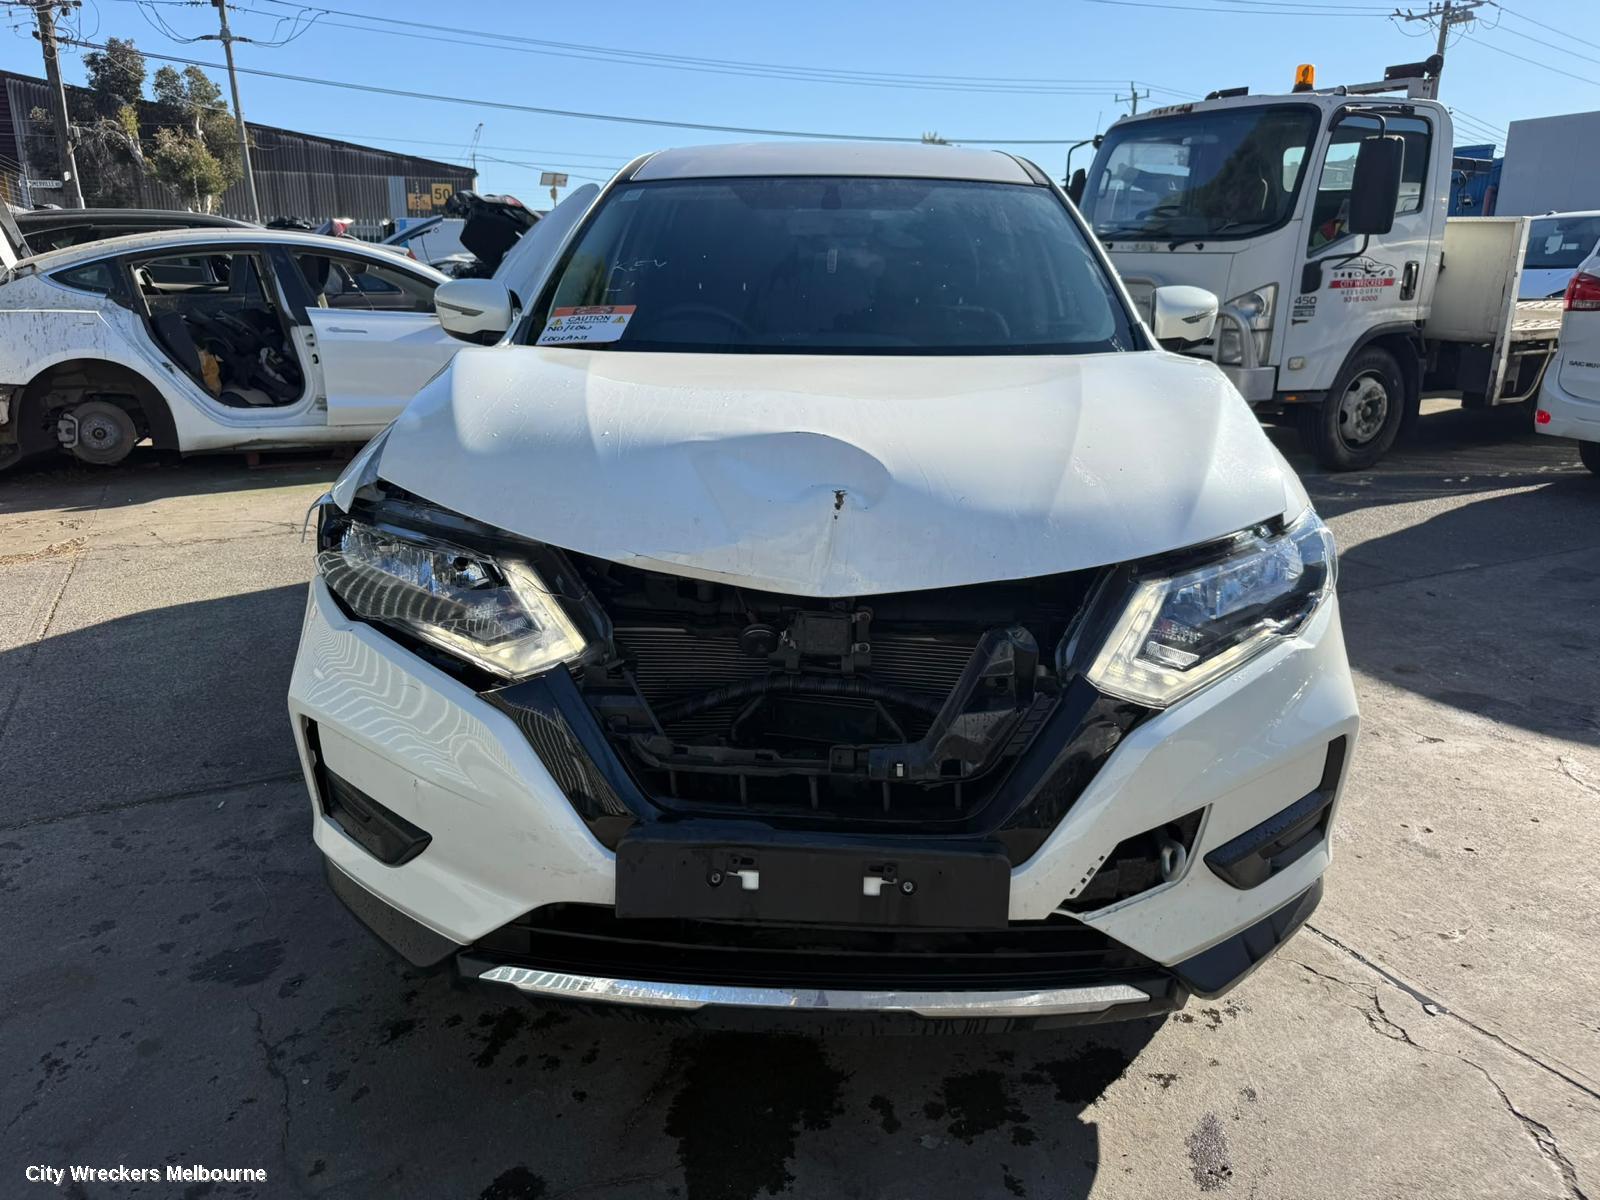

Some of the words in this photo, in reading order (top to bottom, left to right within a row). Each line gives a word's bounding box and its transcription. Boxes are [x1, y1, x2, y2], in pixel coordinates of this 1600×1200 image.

[434, 188, 450, 200] 50
[1339, 279, 1353, 288] CITY
[1354, 278, 1385, 287] WRECKERS
[1294, 296, 1317, 305] 450
